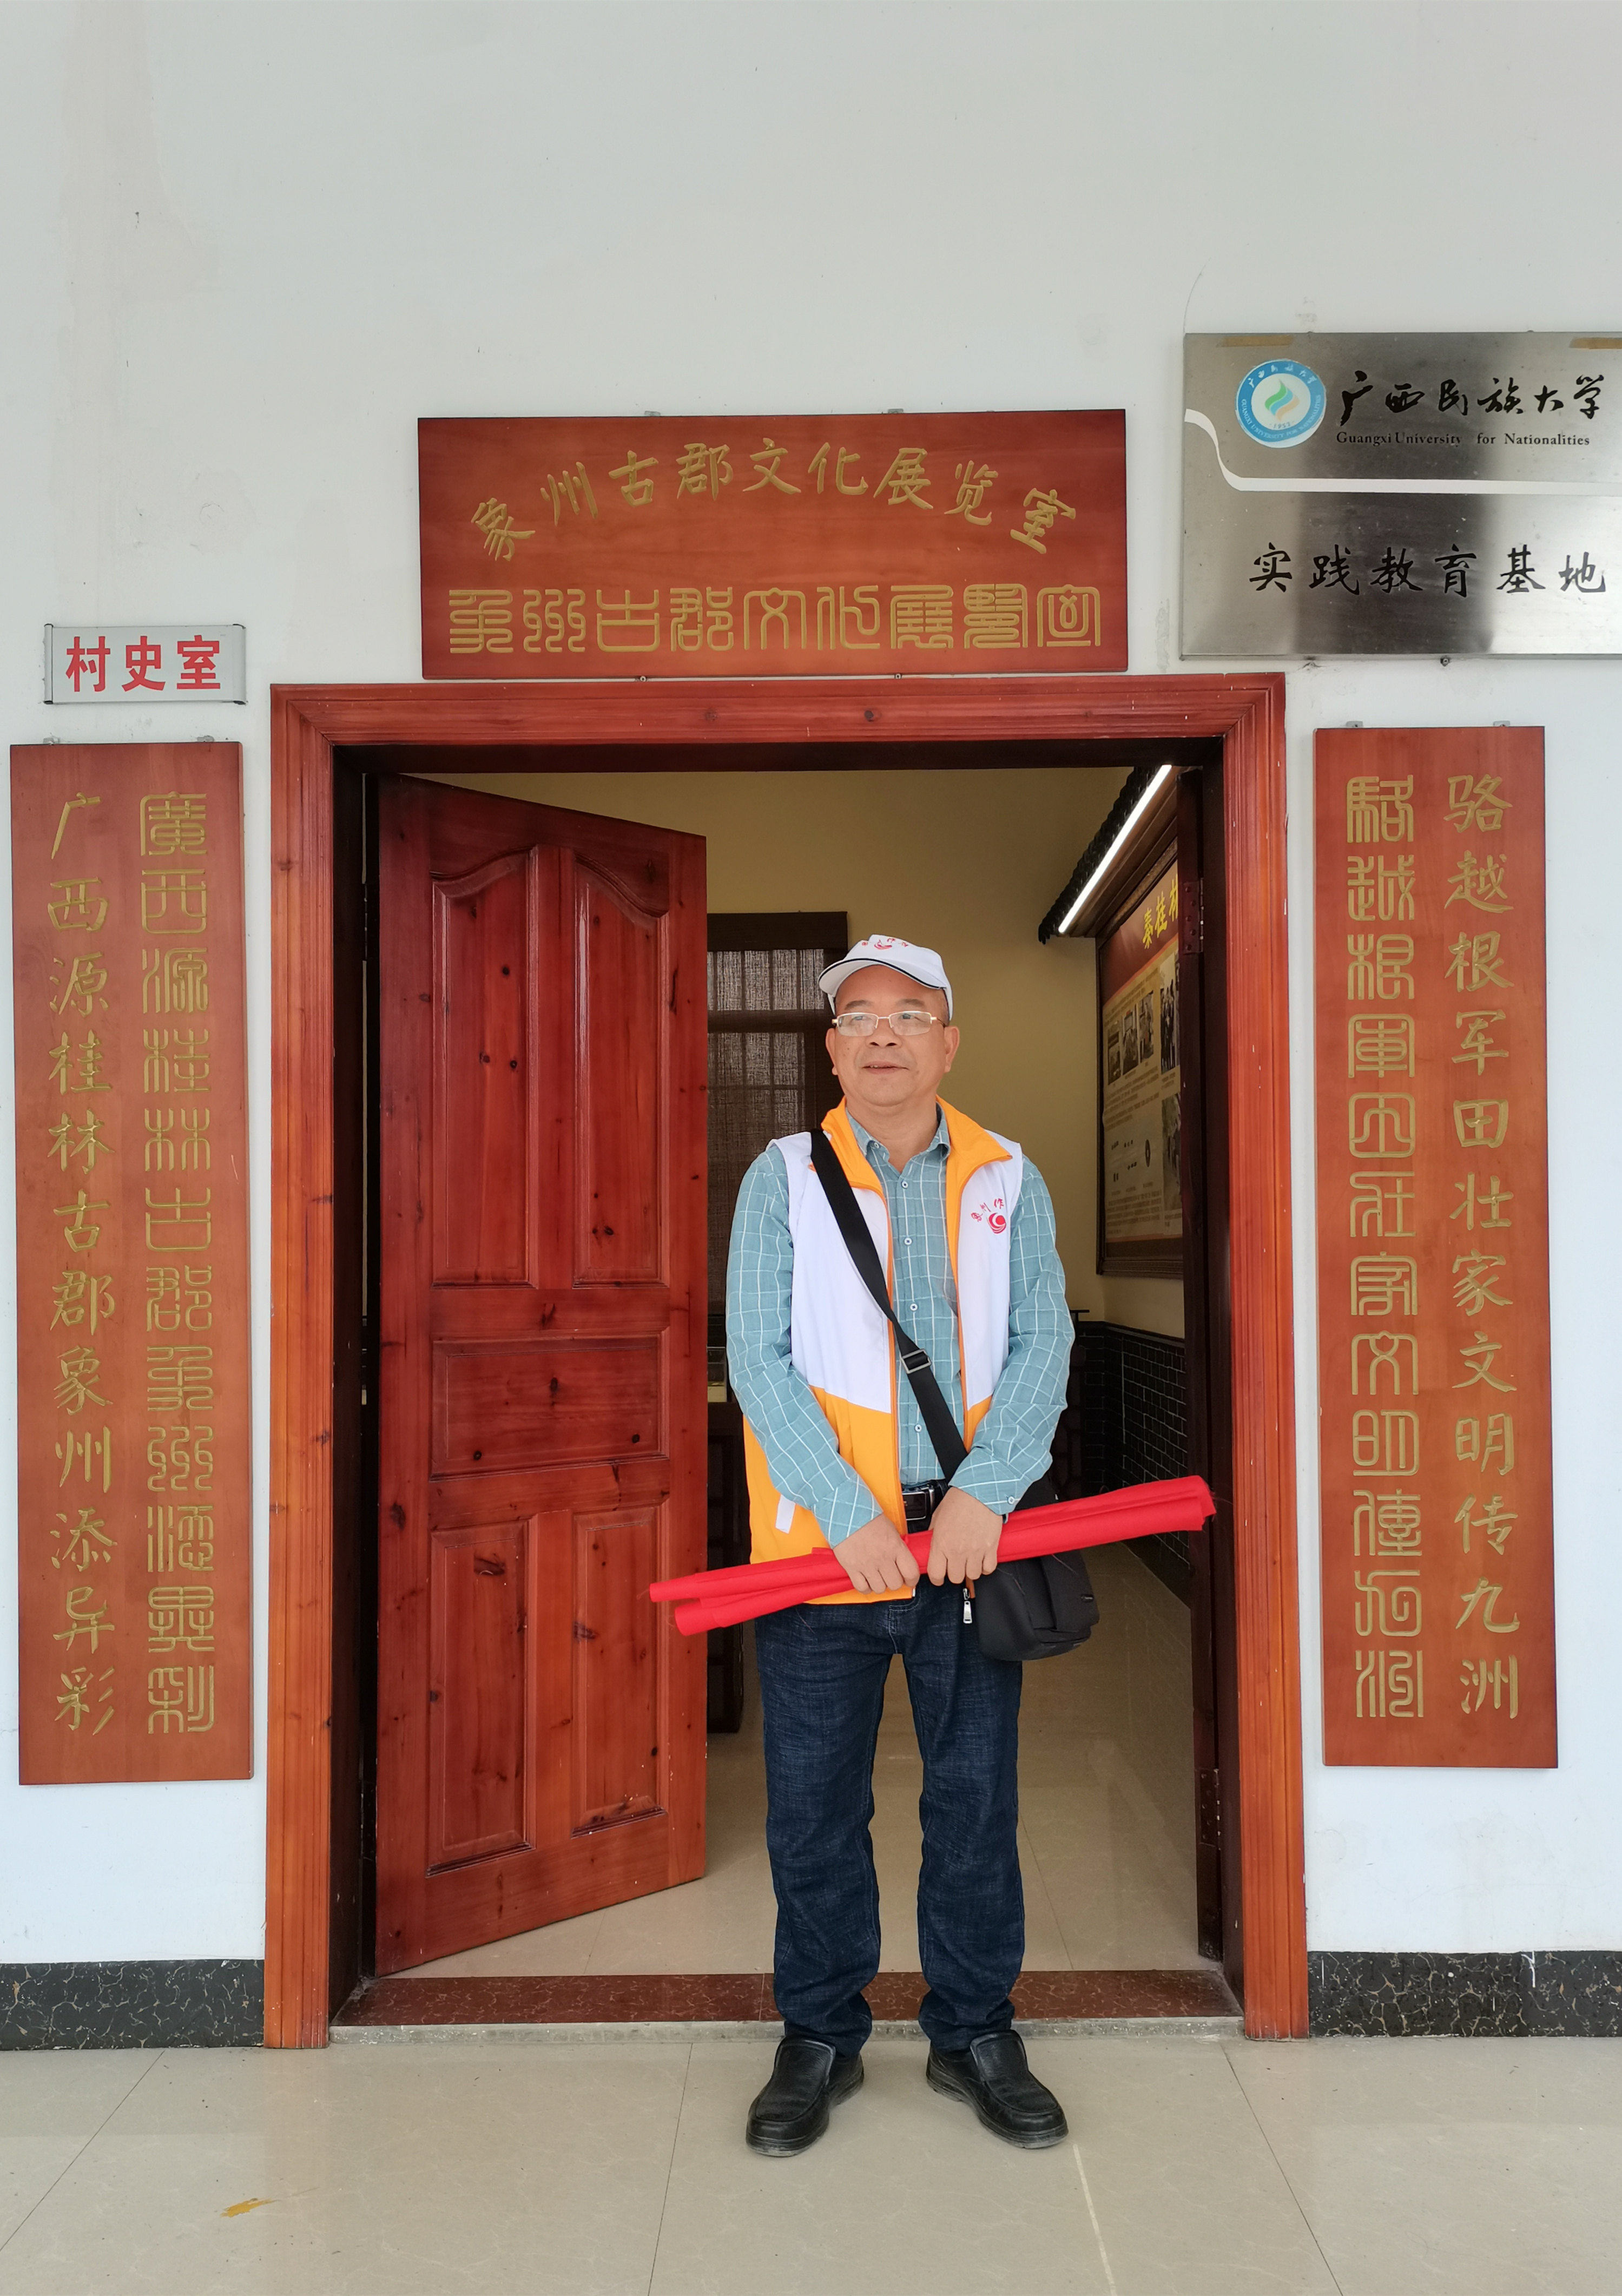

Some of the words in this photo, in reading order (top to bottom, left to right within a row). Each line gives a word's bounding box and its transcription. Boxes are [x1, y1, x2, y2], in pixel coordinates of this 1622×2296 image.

[1340, 370, 1604, 426] 广西民族大学
[1336, 432, 1392, 446] Guangxi
[1395, 432, 1462, 447] University
[1477, 433, 1496, 445] for
[1504, 433, 1590, 445] Nationalities
[471, 438, 1076, 561] 象州古郡文化展览室
[1249, 542, 1606, 597] 实践教育基地
[65, 635, 220, 692] 村史室
[48, 792, 117, 1735] 广西源桂林古郡象州添异彩
[1444, 774, 1520, 1719] 骆越根军田壮家文明传九洲
